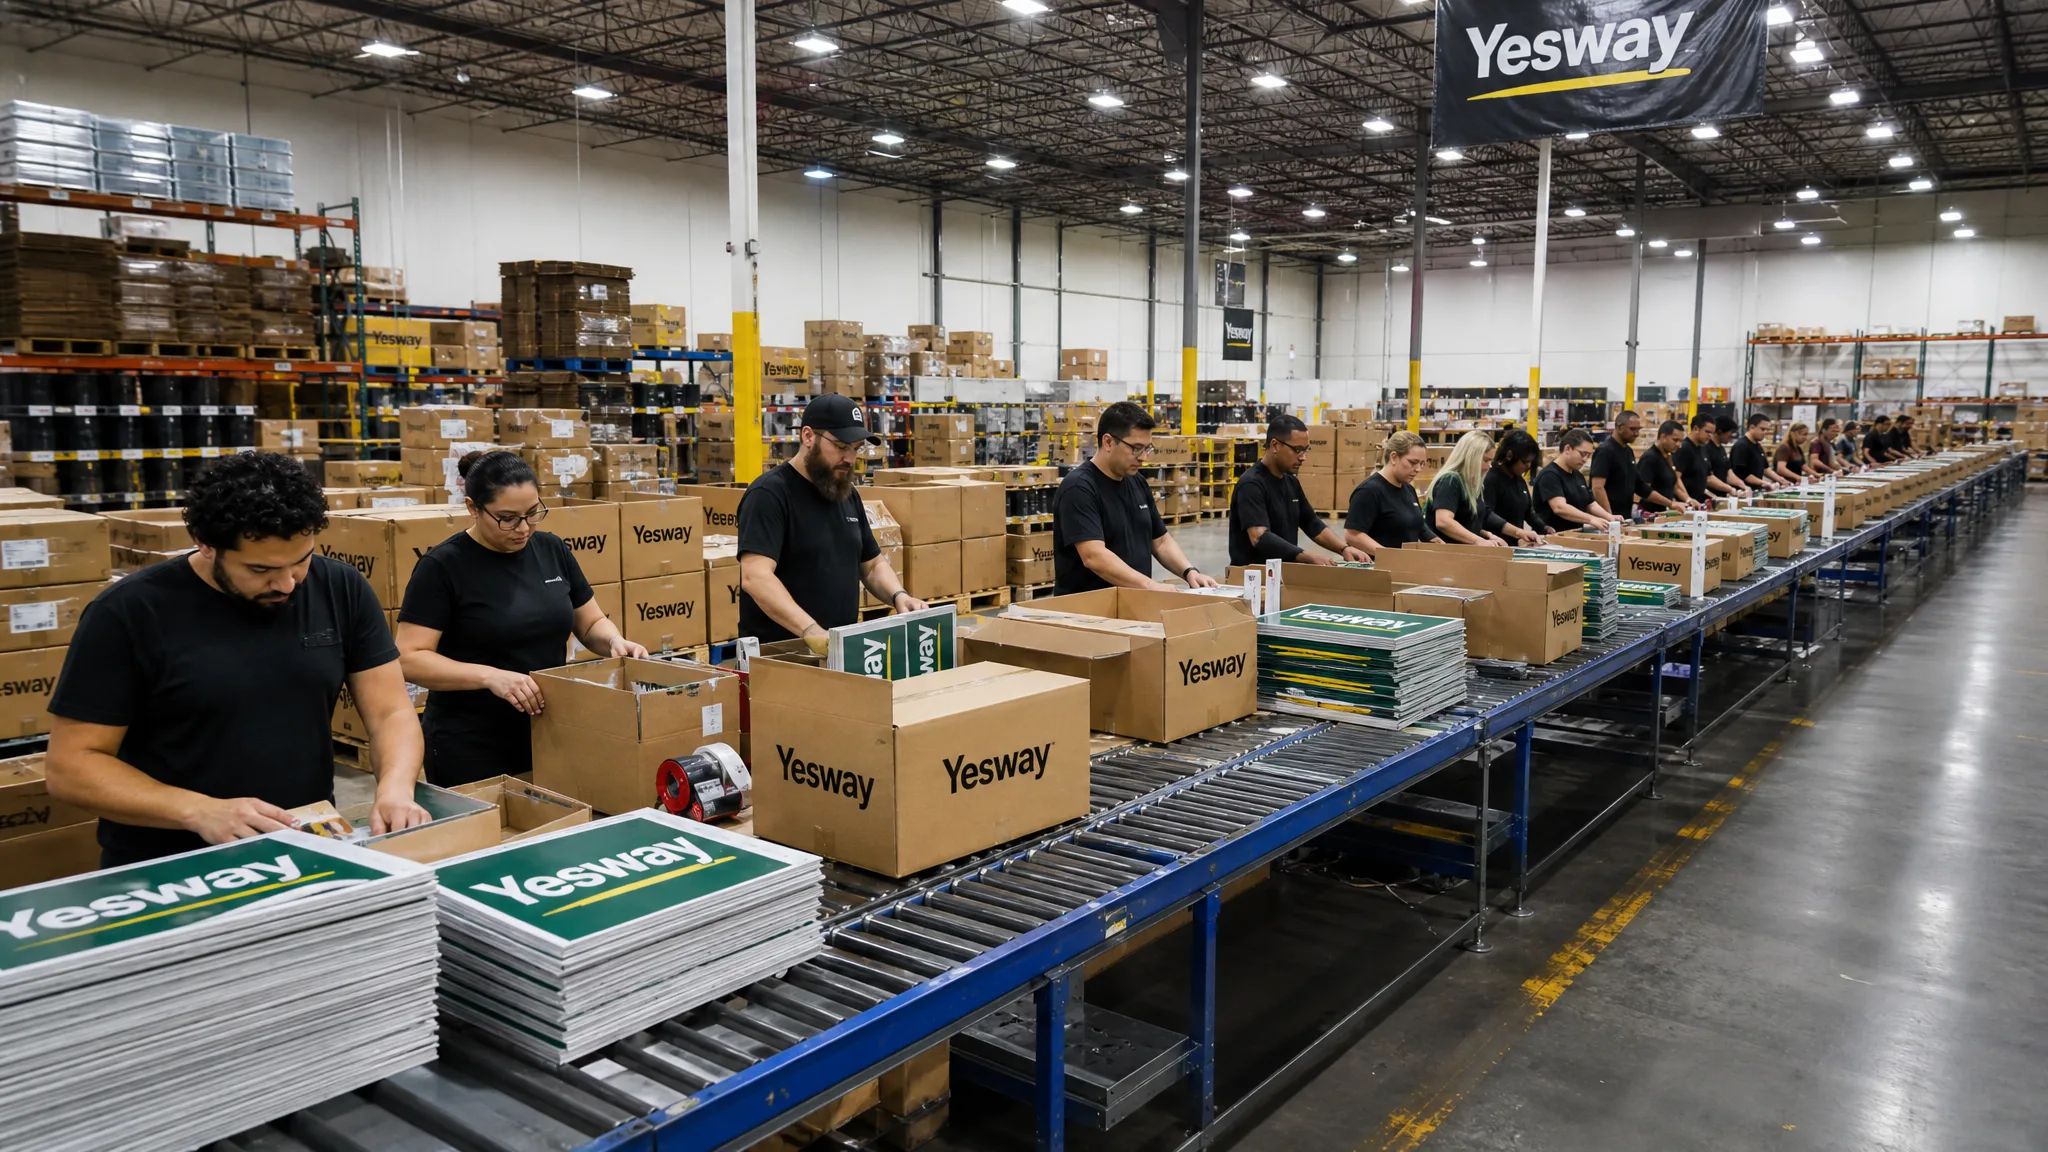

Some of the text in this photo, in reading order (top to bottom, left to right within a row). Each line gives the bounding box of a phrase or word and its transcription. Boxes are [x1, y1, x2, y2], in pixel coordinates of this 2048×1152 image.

[1466, 11, 1695, 78] Yesway
[373, 331, 422, 349] Yesway
[564, 534, 607, 553] sway
[633, 525, 692, 544] Yesway
[1628, 556, 1681, 576] Yesway
[636, 601, 694, 621] Yesway
[1290, 608, 1422, 630] Yesway
[1552, 606, 1579, 628] Yesway
[919, 624, 938, 675] way
[1178, 652, 1246, 687] Yesway
[0, 676, 55, 697] sway
[776, 744, 875, 810] Yesway
[943, 743, 1051, 794] Yesway
[469, 836, 713, 906] Yesway
[0, 853, 302, 940] Yesway
